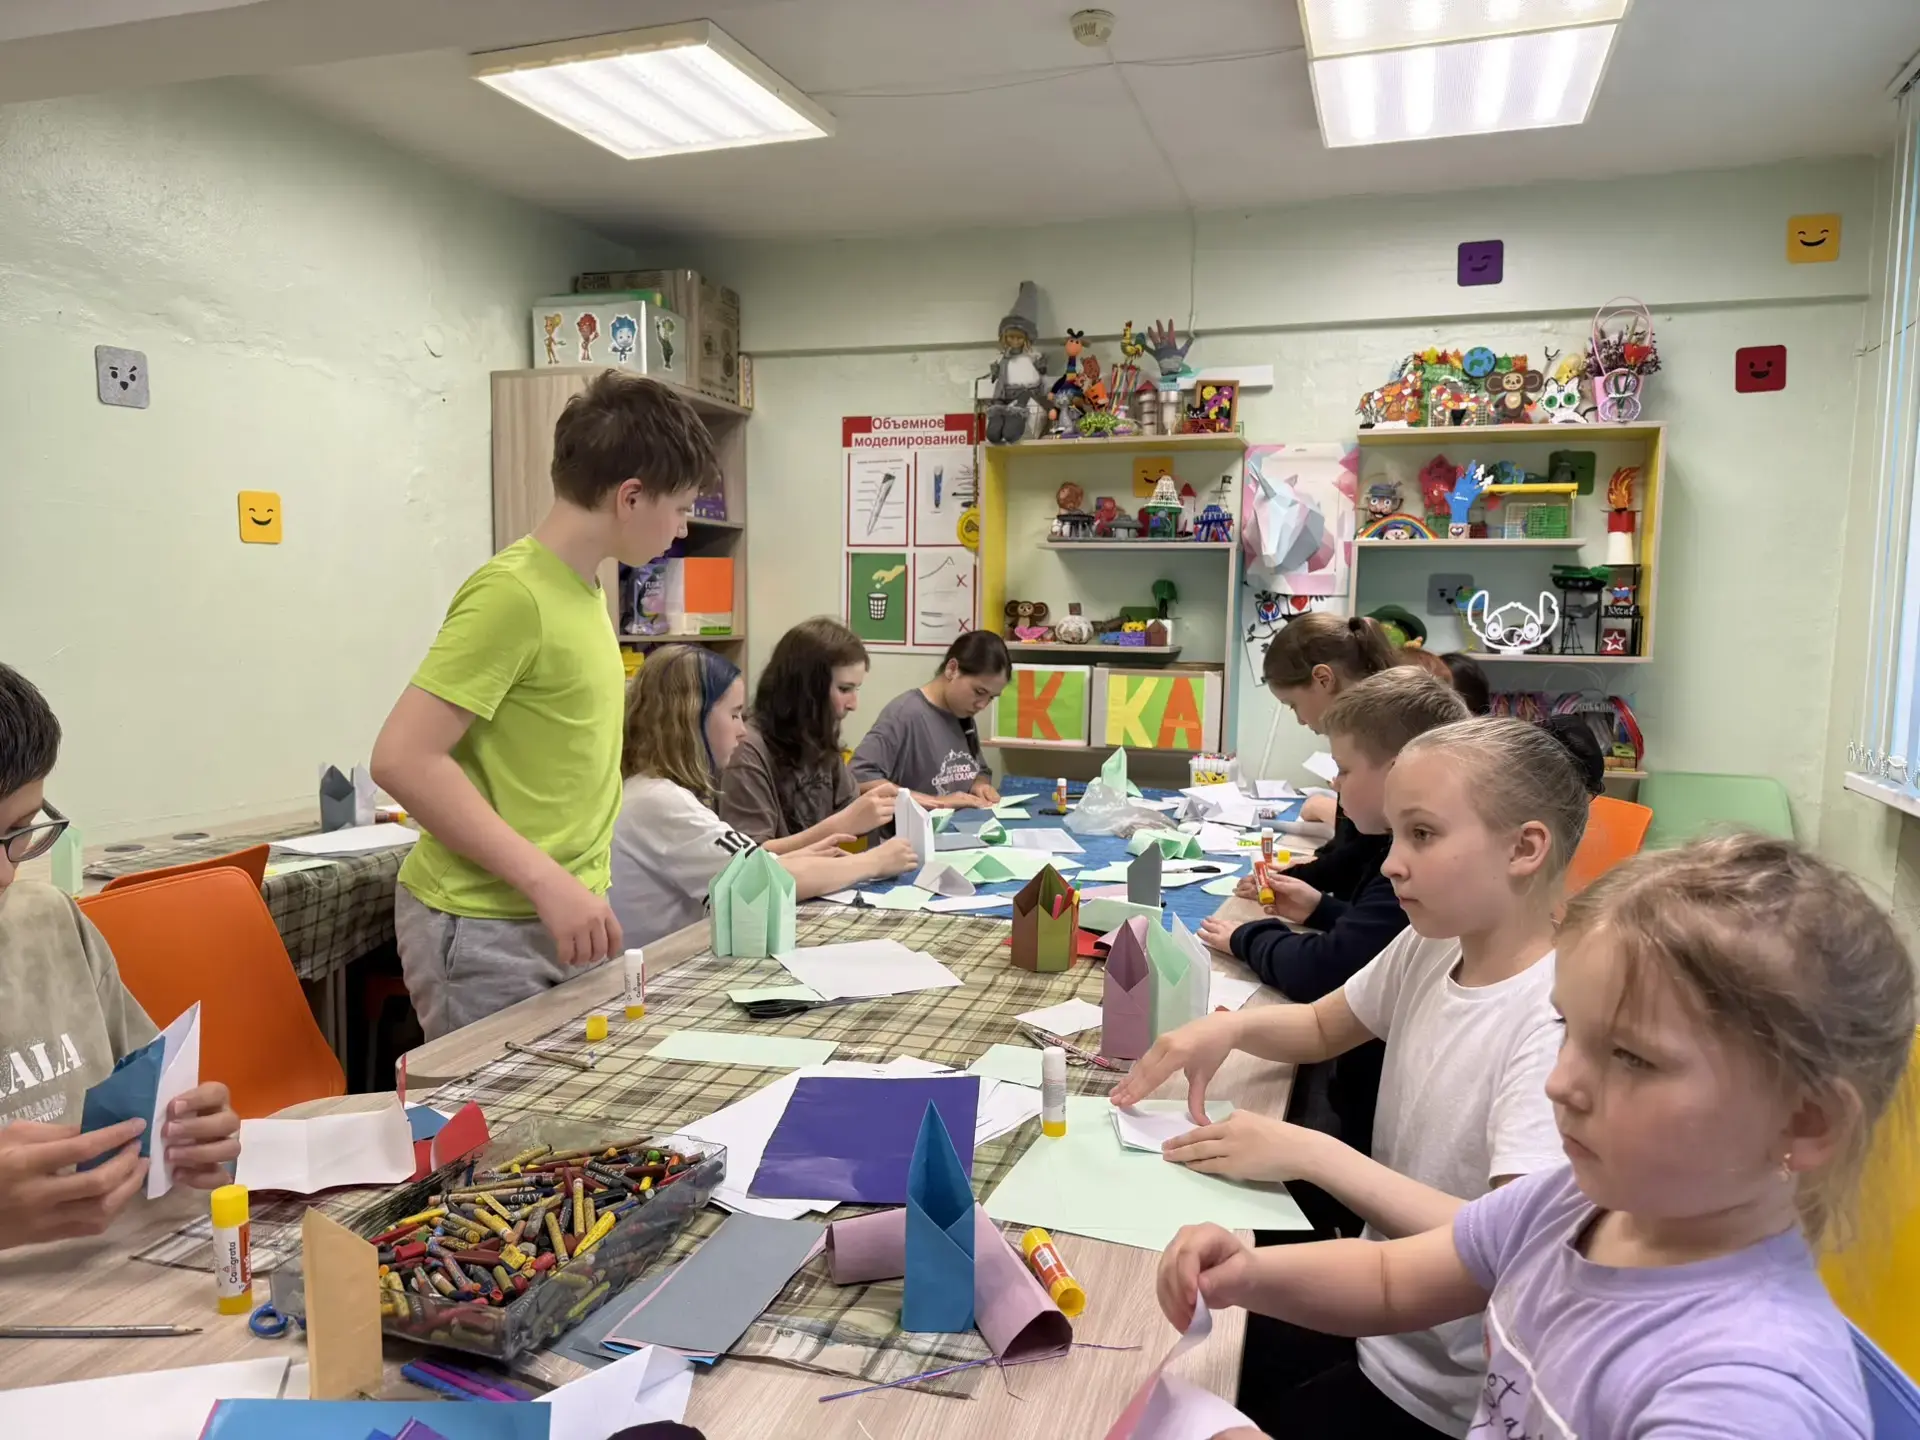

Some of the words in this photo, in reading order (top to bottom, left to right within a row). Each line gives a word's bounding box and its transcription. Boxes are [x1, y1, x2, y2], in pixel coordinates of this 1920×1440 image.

[872, 416, 945, 430] Объемное
[854, 434, 967, 449] моделирование
[0, 1032, 83, 1099] ALA
